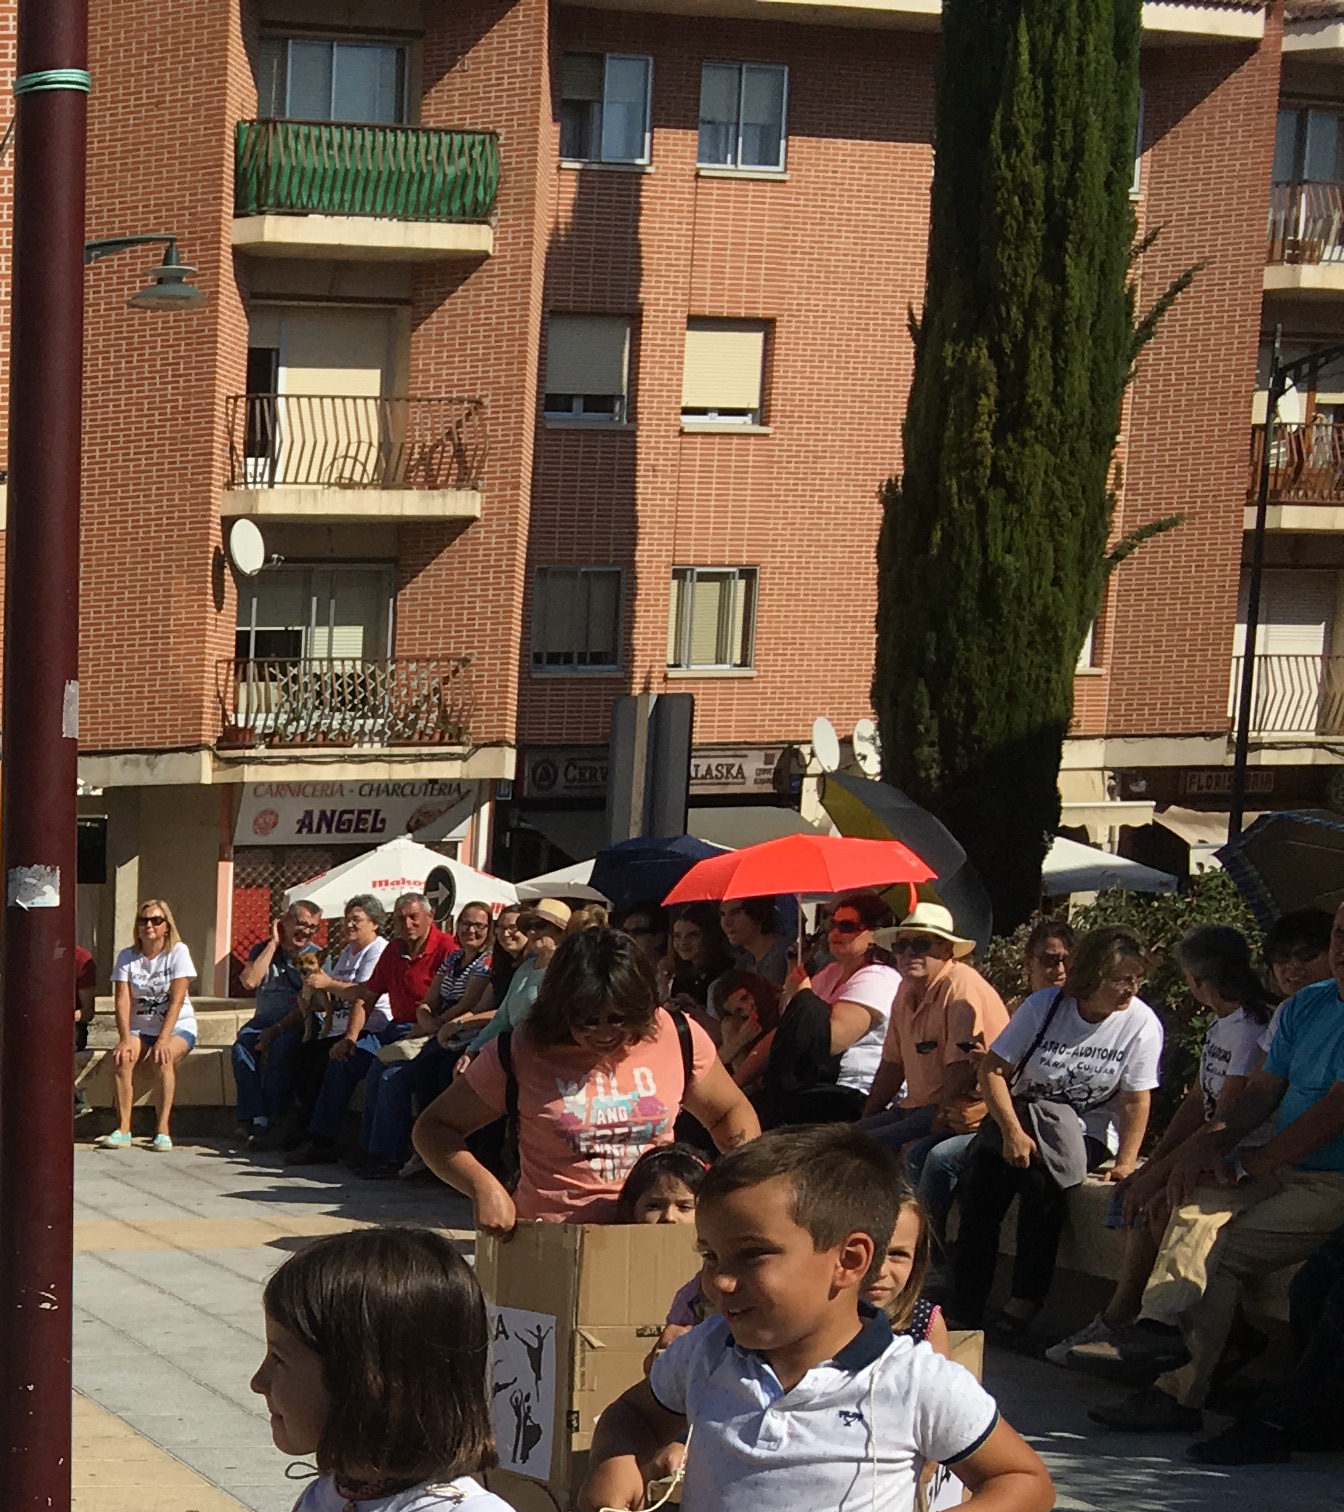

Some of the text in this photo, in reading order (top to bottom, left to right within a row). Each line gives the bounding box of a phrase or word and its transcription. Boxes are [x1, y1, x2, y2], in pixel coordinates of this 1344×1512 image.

[689, 763, 746, 782] LASKA
[295, 808, 387, 836] ANGEL
[596, 1106, 630, 1125] AND
